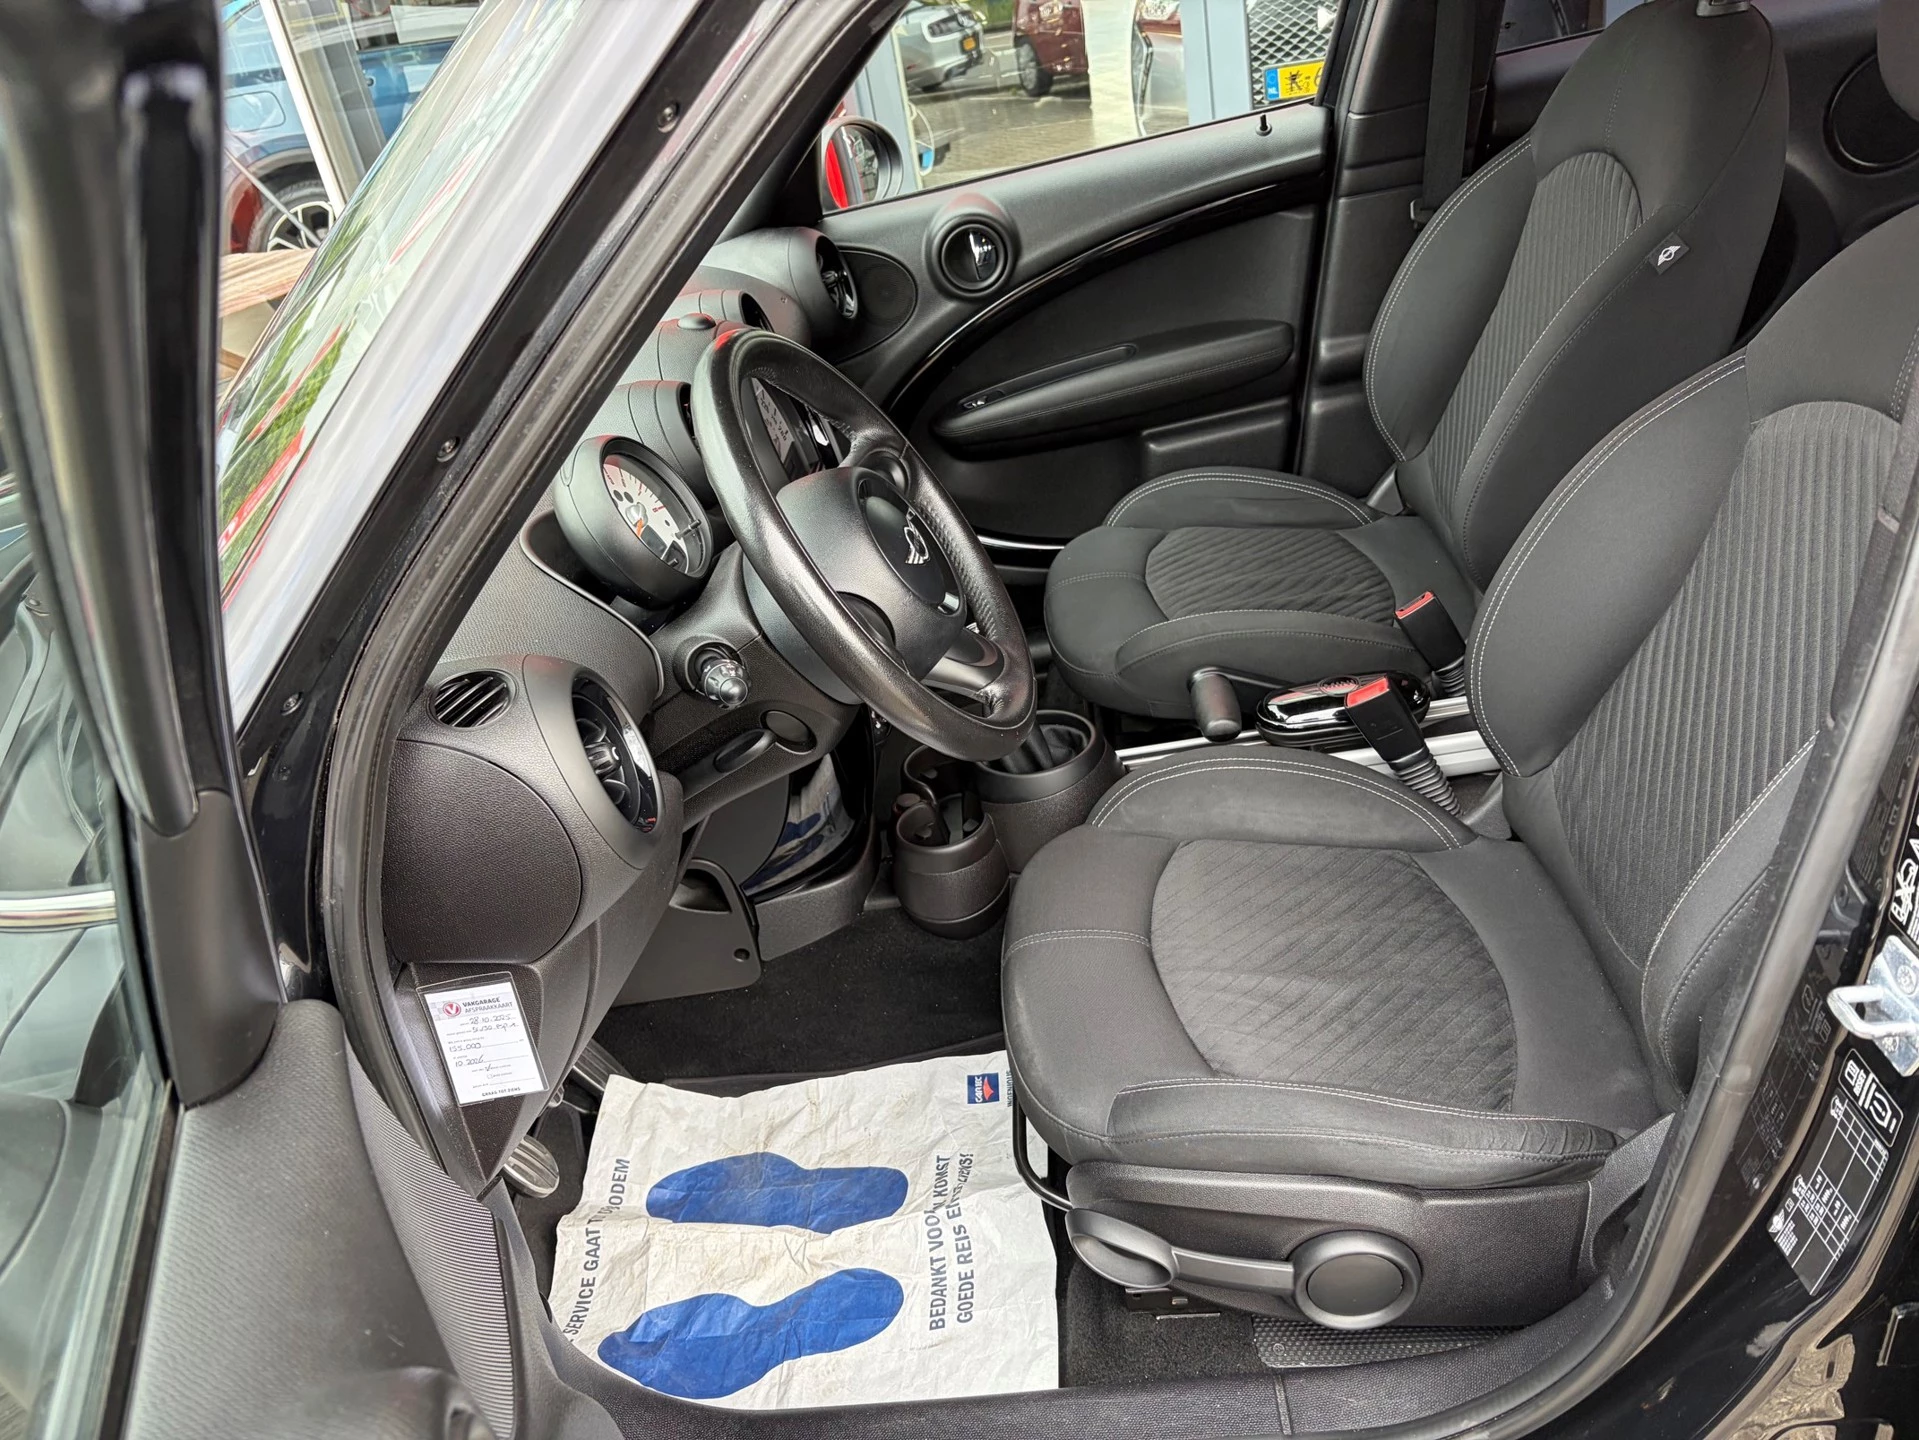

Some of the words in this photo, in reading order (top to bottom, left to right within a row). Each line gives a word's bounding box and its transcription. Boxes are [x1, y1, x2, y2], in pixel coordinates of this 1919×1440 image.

[462, 997, 501, 1007] VAKGARAGE
[465, 1001, 513, 1013] AFSPRAAKKAART
[933, 1155, 951, 1198] KOMST
[953, 1224, 973, 1265] REIS
[563, 1276, 596, 1335] SERVICE
[583, 1227, 601, 1271] GAAT
[929, 1256, 948, 1331] BEDANKT
[956, 1269, 974, 1323] GOEDE
